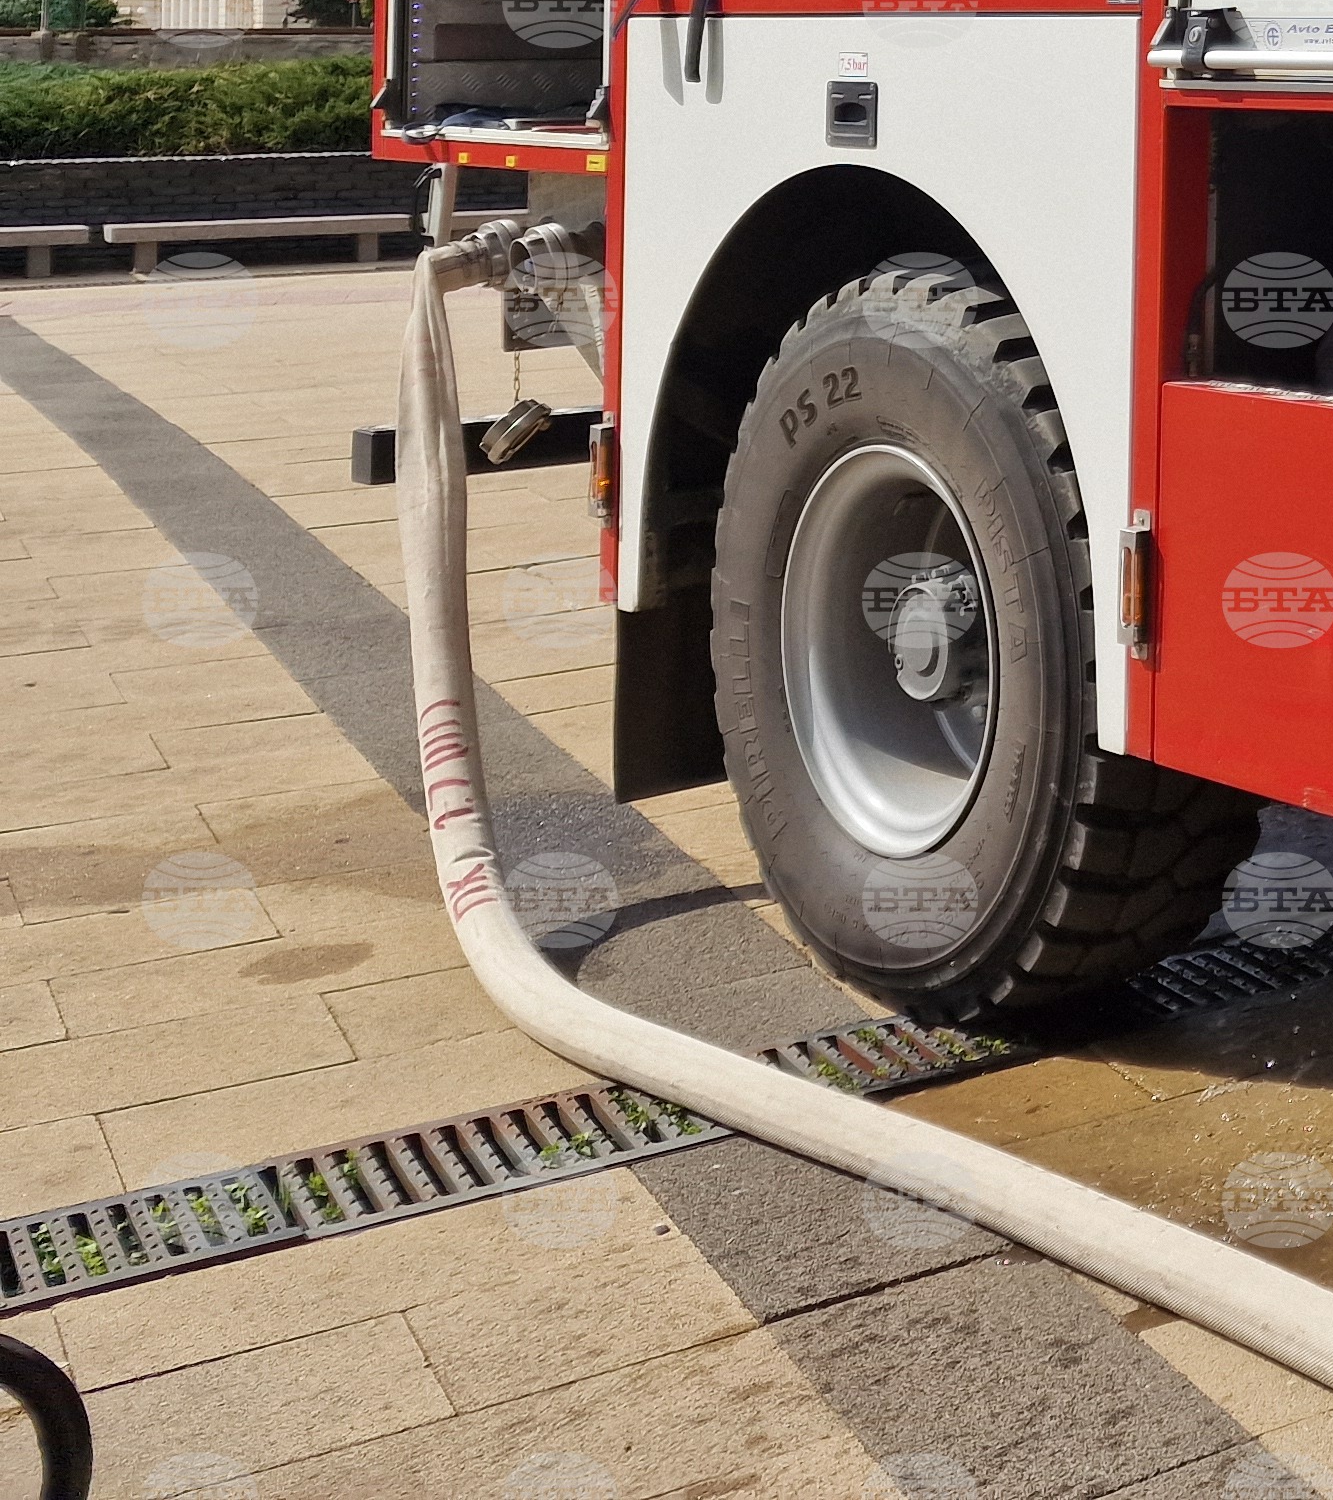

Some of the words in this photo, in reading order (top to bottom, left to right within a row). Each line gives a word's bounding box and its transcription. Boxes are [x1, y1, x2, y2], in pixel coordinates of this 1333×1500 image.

[1286, 24, 1320, 35] Avto
[779, 387, 819, 450] PS
[822, 365, 863, 411] 22
